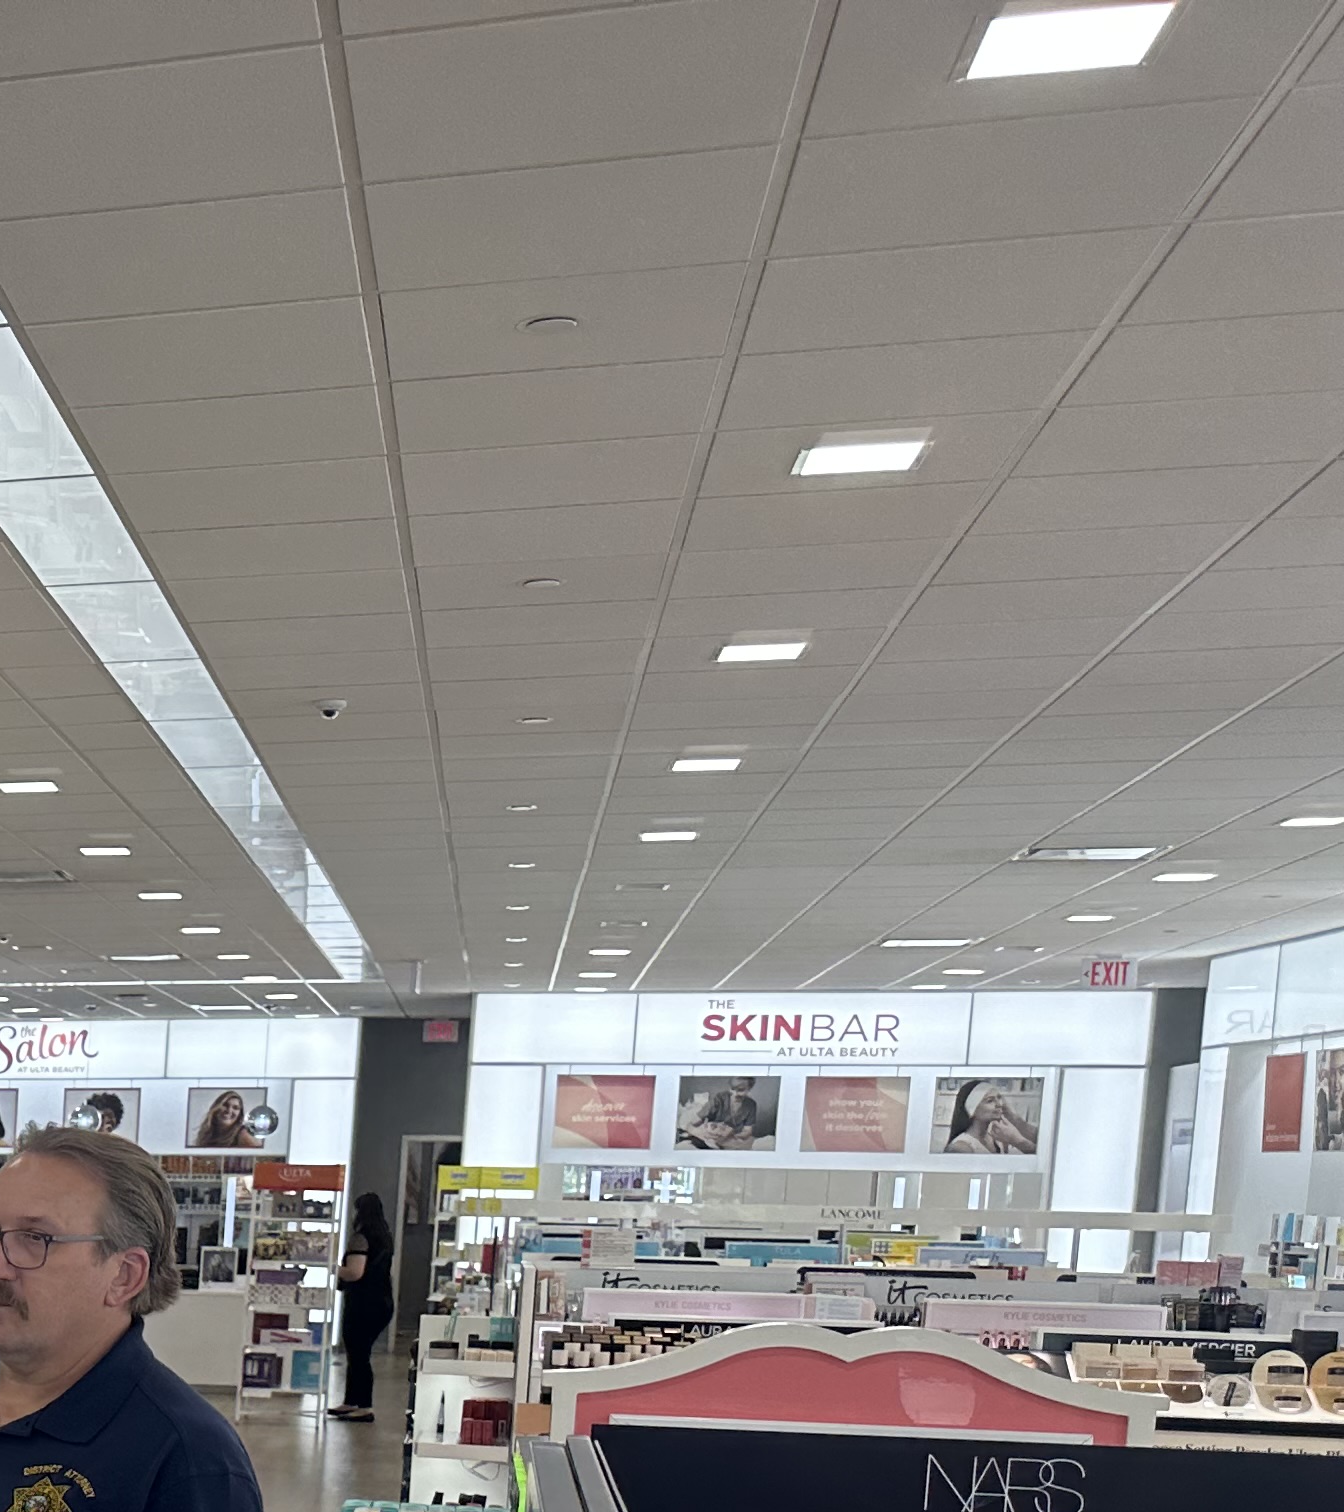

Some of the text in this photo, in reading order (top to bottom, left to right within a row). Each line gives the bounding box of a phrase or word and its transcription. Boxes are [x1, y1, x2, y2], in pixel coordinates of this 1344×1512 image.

[1090, 961, 1130, 986] EXIT
[708, 999, 735, 1009] THE
[21, 1025, 37, 1038] the
[776, 1047, 899, 1057] AT ULTA BEAUTY
[829, 1099, 884, 1110] show your
[571, 1114, 637, 1123] skin services
[822, 1111, 844, 1120] skin
[846, 1111, 864, 1120] the
[825, 1123, 883, 1132] it deserves
[283, 1168, 312, 1178] ULTA
[887, 1279, 929, 1305] it
[681, 1302, 731, 1310] COSMETICS
[1004, 1312, 1087, 1324] KYLIE COSMETICS
[23, 1464, 96, 1499] DISTRICT ATTORNEY
